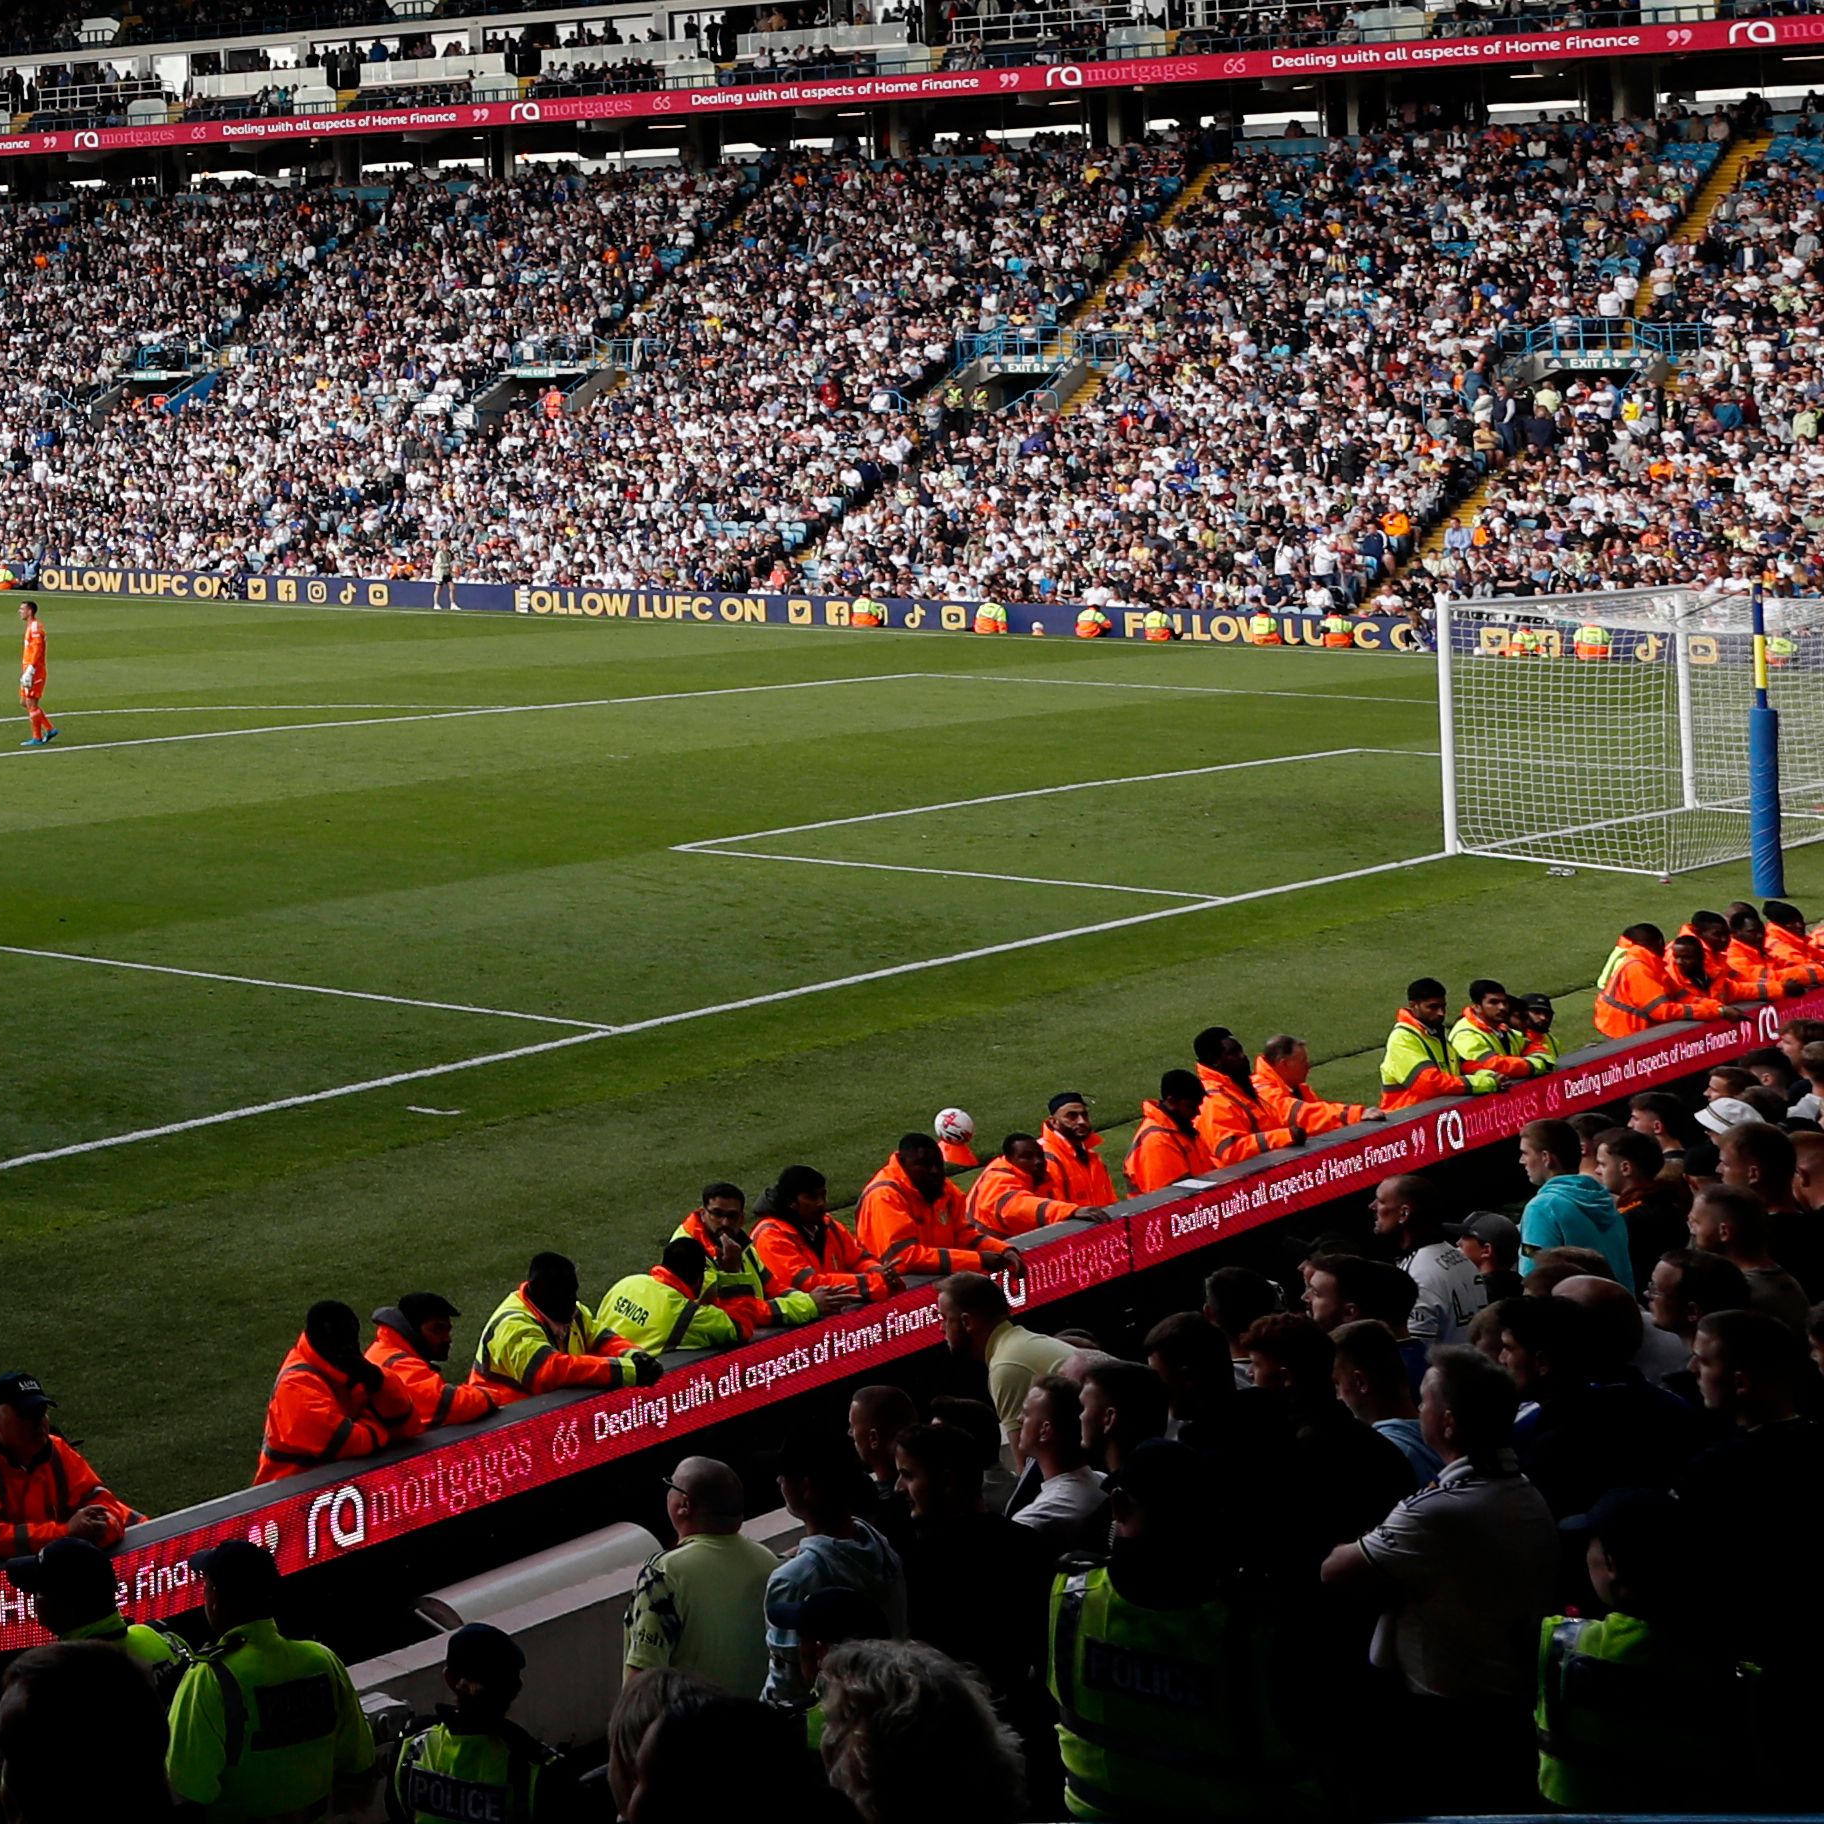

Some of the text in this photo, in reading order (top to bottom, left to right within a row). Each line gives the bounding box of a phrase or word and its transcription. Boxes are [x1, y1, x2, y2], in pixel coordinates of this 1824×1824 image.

[1272, 34, 1640, 68] Dealing with all aspects of Home Finance
[1087, 62, 1198, 82] mortgages
[691, 77, 979, 106] Dealing with all aspects of Home Finance
[543, 98, 632, 118] mortgages
[102, 129, 174, 145] mortgages
[222, 112, 456, 136] Dealing with all aspects of Home Finance
[1007, 363, 1031, 373] EXIT
[1569, 358, 1598, 368] EXIT
[42, 571, 122, 592] OLLOW
[128, 573, 188, 596] LUFC
[639, 594, 712, 619] LUFC
[720, 598, 767, 622] ON
[1283, 618, 1381, 649] LUC
[1564, 1029, 1737, 1099] Dealing with all aspects of Home Finance
[1464, 1092, 1538, 1138] mortgages
[1171, 1140, 1407, 1237] Dealing with all aspects of Home Finance
[614, 1296, 649, 1327] SENIOR
[594, 1303, 944, 1442] Dealing with all aspects of Home Financ
[371, 1440, 532, 1526] mortgages
[414, 1775, 502, 1821] POLICE
